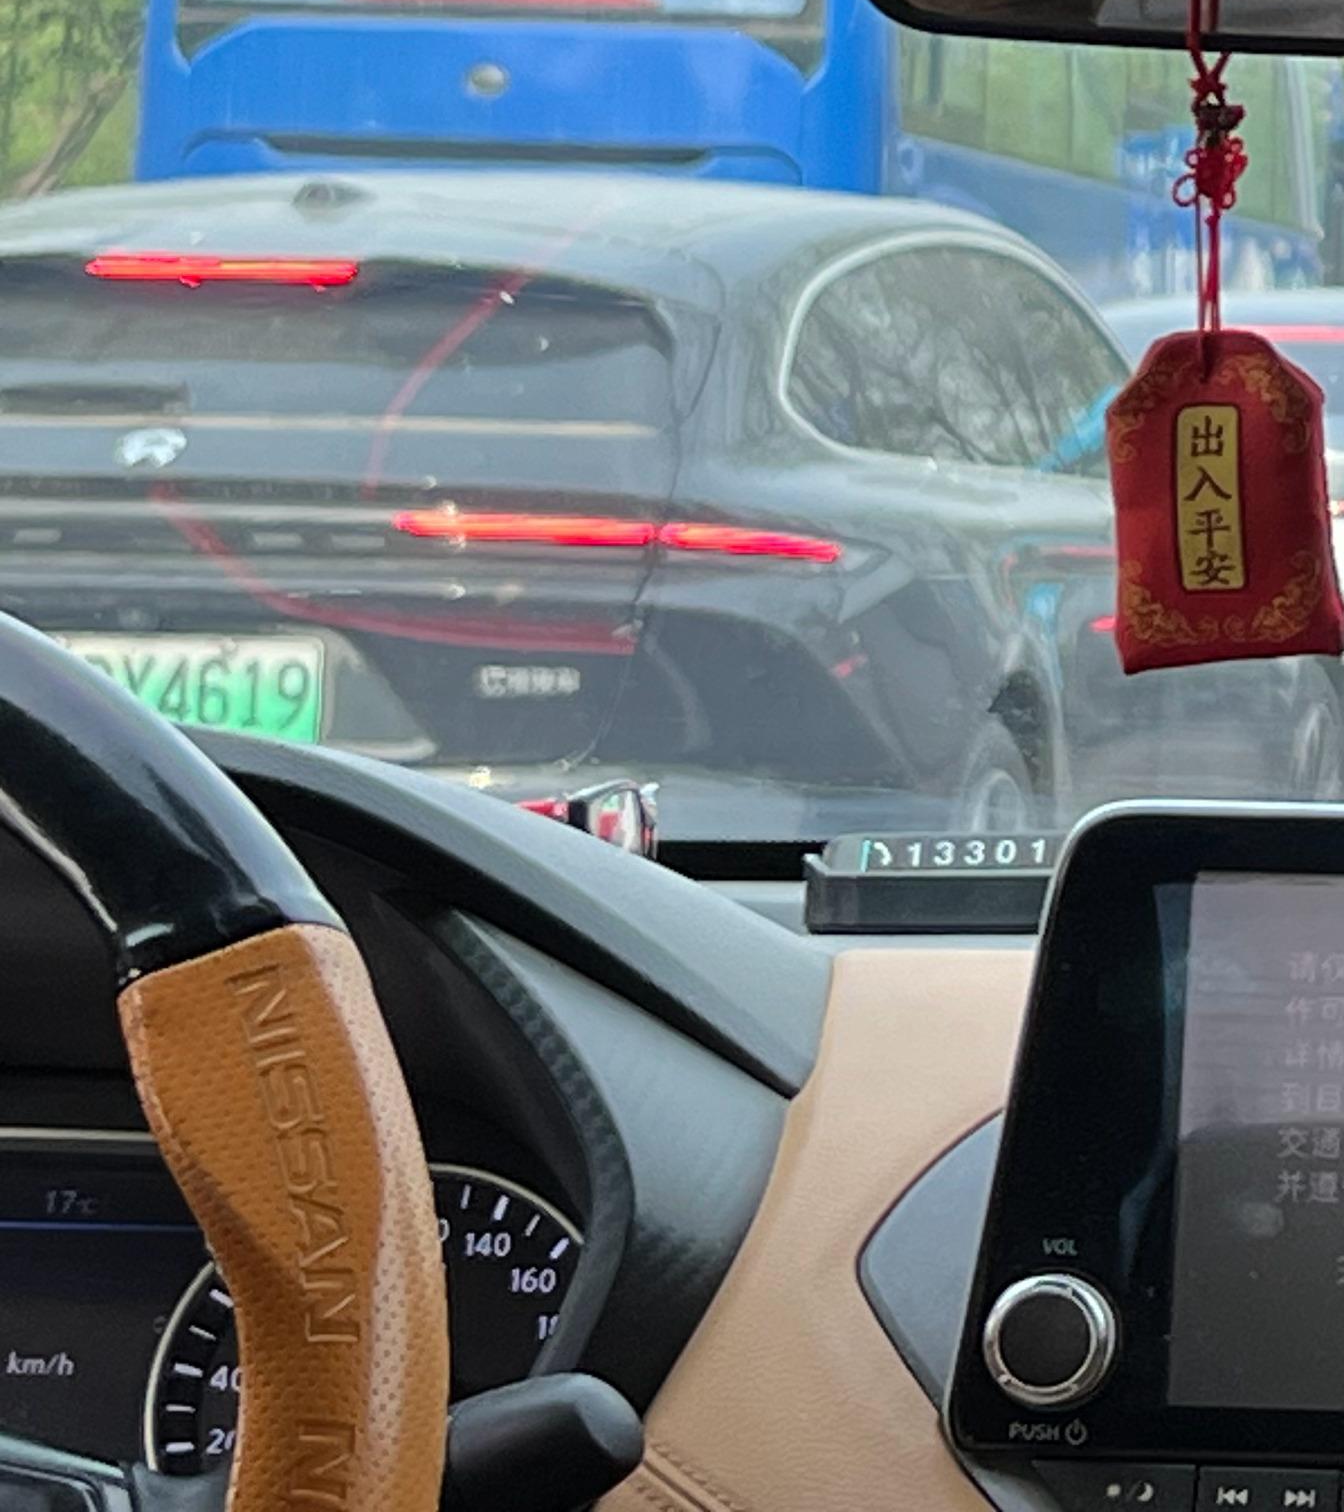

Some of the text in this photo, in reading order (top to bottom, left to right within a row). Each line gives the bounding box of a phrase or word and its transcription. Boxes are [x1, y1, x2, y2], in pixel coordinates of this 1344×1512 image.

[1184, 415, 1236, 586] 出入平安
[225, 960, 362, 1344] NISSAN
[465, 1232, 511, 1257] 140
[1042, 1239, 1077, 1256] VOL
[511, 1267, 556, 1293] 160
[5, 1350, 75, 1376] km/h
[1009, 1422, 1060, 1440] PUSH
